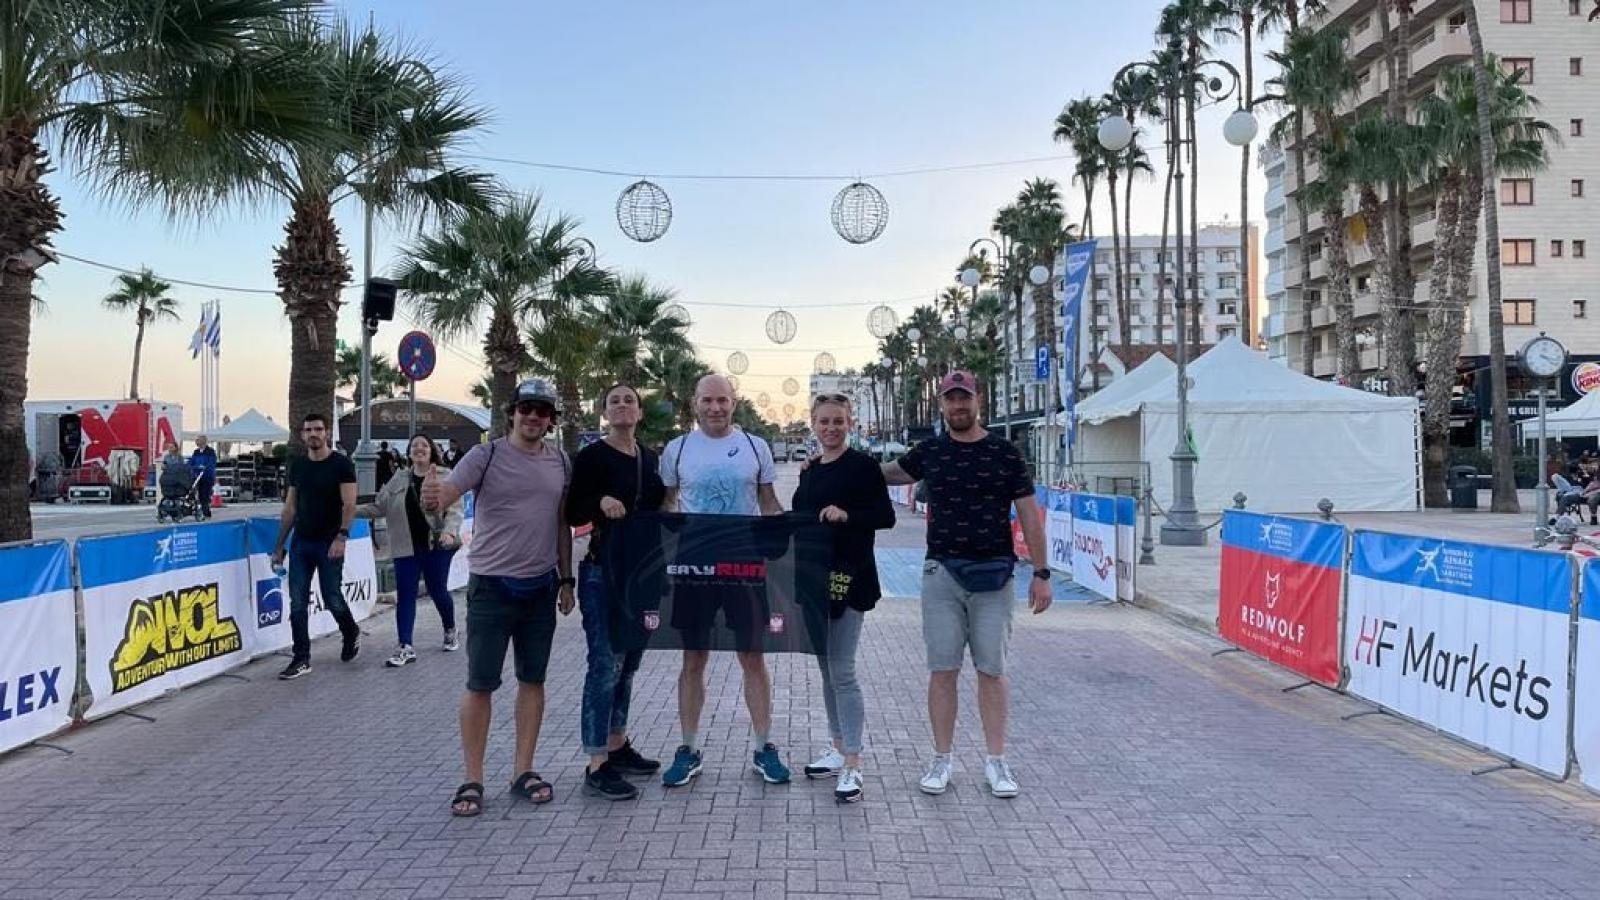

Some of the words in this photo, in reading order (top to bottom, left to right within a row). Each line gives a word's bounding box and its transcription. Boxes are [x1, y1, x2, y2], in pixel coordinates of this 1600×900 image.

[259, 610, 281, 625] CNP
[1241, 605, 1304, 643] REDWOLF
[1355, 616, 1397, 667] HF
[1402, 626, 1552, 720] Markets
[0, 666, 62, 723] LEX
